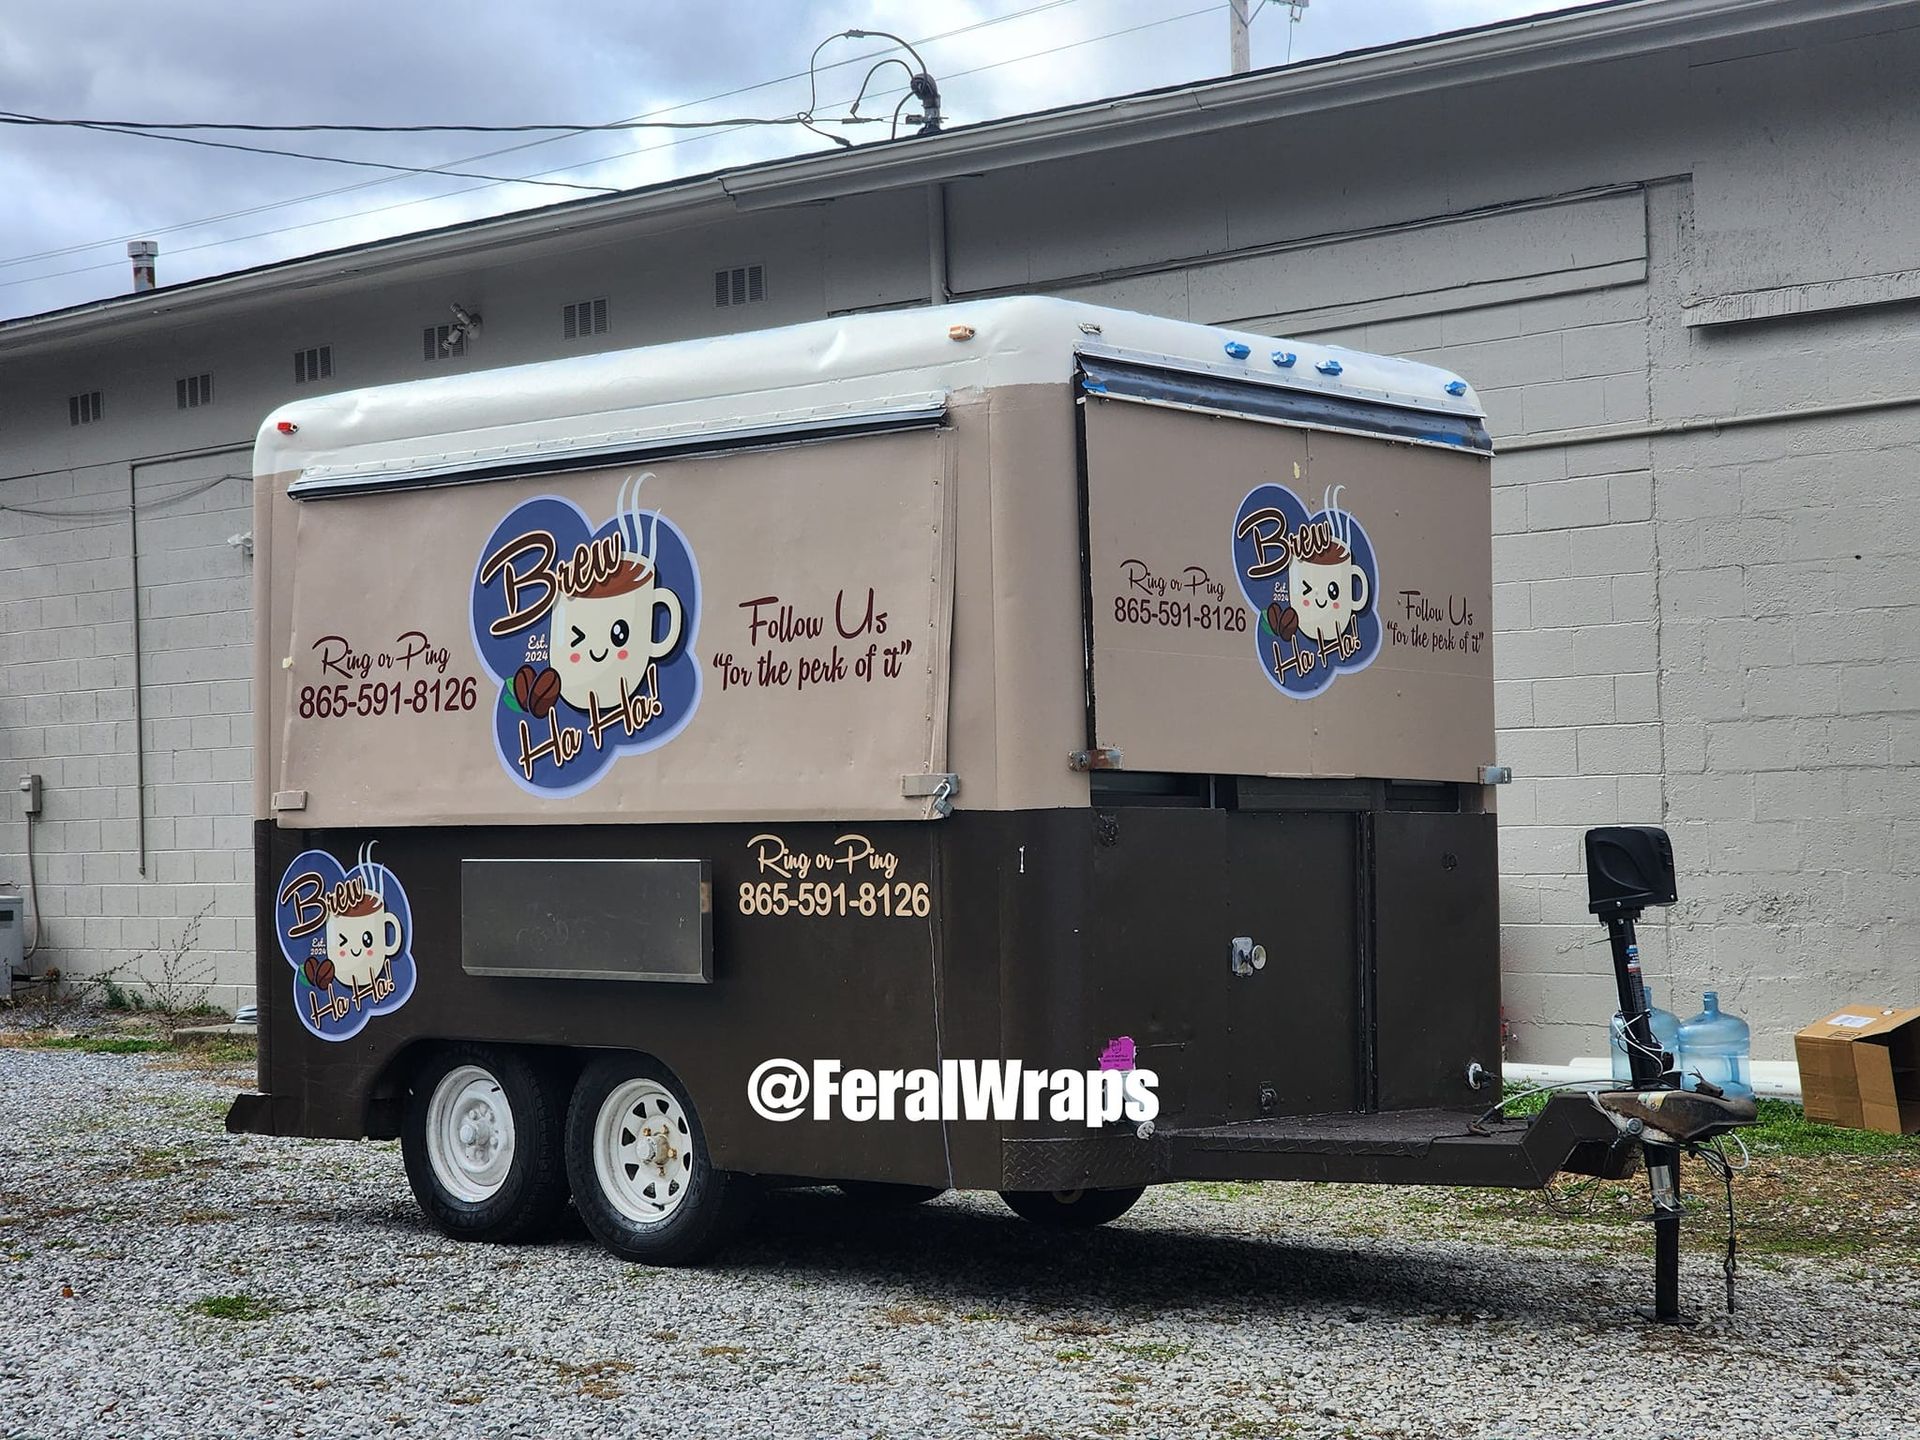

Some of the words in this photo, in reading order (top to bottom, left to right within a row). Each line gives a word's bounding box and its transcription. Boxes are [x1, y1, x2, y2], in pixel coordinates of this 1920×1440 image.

[1237, 507, 1332, 578] Brew
[480, 530, 622, 635] Brew
[1120, 559, 1167, 596] Ring
[1170, 578, 1183, 592] or
[1183, 566, 1226, 601] Ping
[739, 596, 824, 646] Follow
[835, 587, 888, 639] Us
[1114, 596, 1247, 632] 865-591-8126
[1399, 590, 1444, 621] Follow
[1449, 595, 1473, 626] Us
[312, 635, 374, 679] Ring
[377, 653, 394, 669] or
[396, 631, 451, 674] Ping
[525, 651, 549, 662] 2024
[527, 633, 549, 650] Est.
[1273, 634, 1314, 684] Ha
[1317, 615, 1362, 668] Ha!
[1411, 624, 1430, 648] the
[1432, 628, 1457, 652] perk
[1459, 631, 1470, 653] of
[757, 650, 792, 687] the
[798, 645, 848, 690] perk
[855, 643, 878, 682] of
[299, 676, 478, 719] 865-591-8126
[518, 706, 582, 781] Ha
[588, 664, 663, 750] Ha!
[747, 833, 811, 879] Ring
[815, 853, 835, 871] or
[834, 833, 898, 879] Ping
[281, 871, 365, 938] Brew
[738, 882, 930, 917] 865-591-8126
[309, 983, 349, 1030] Ha
[351, 959, 396, 1012] Ha!
